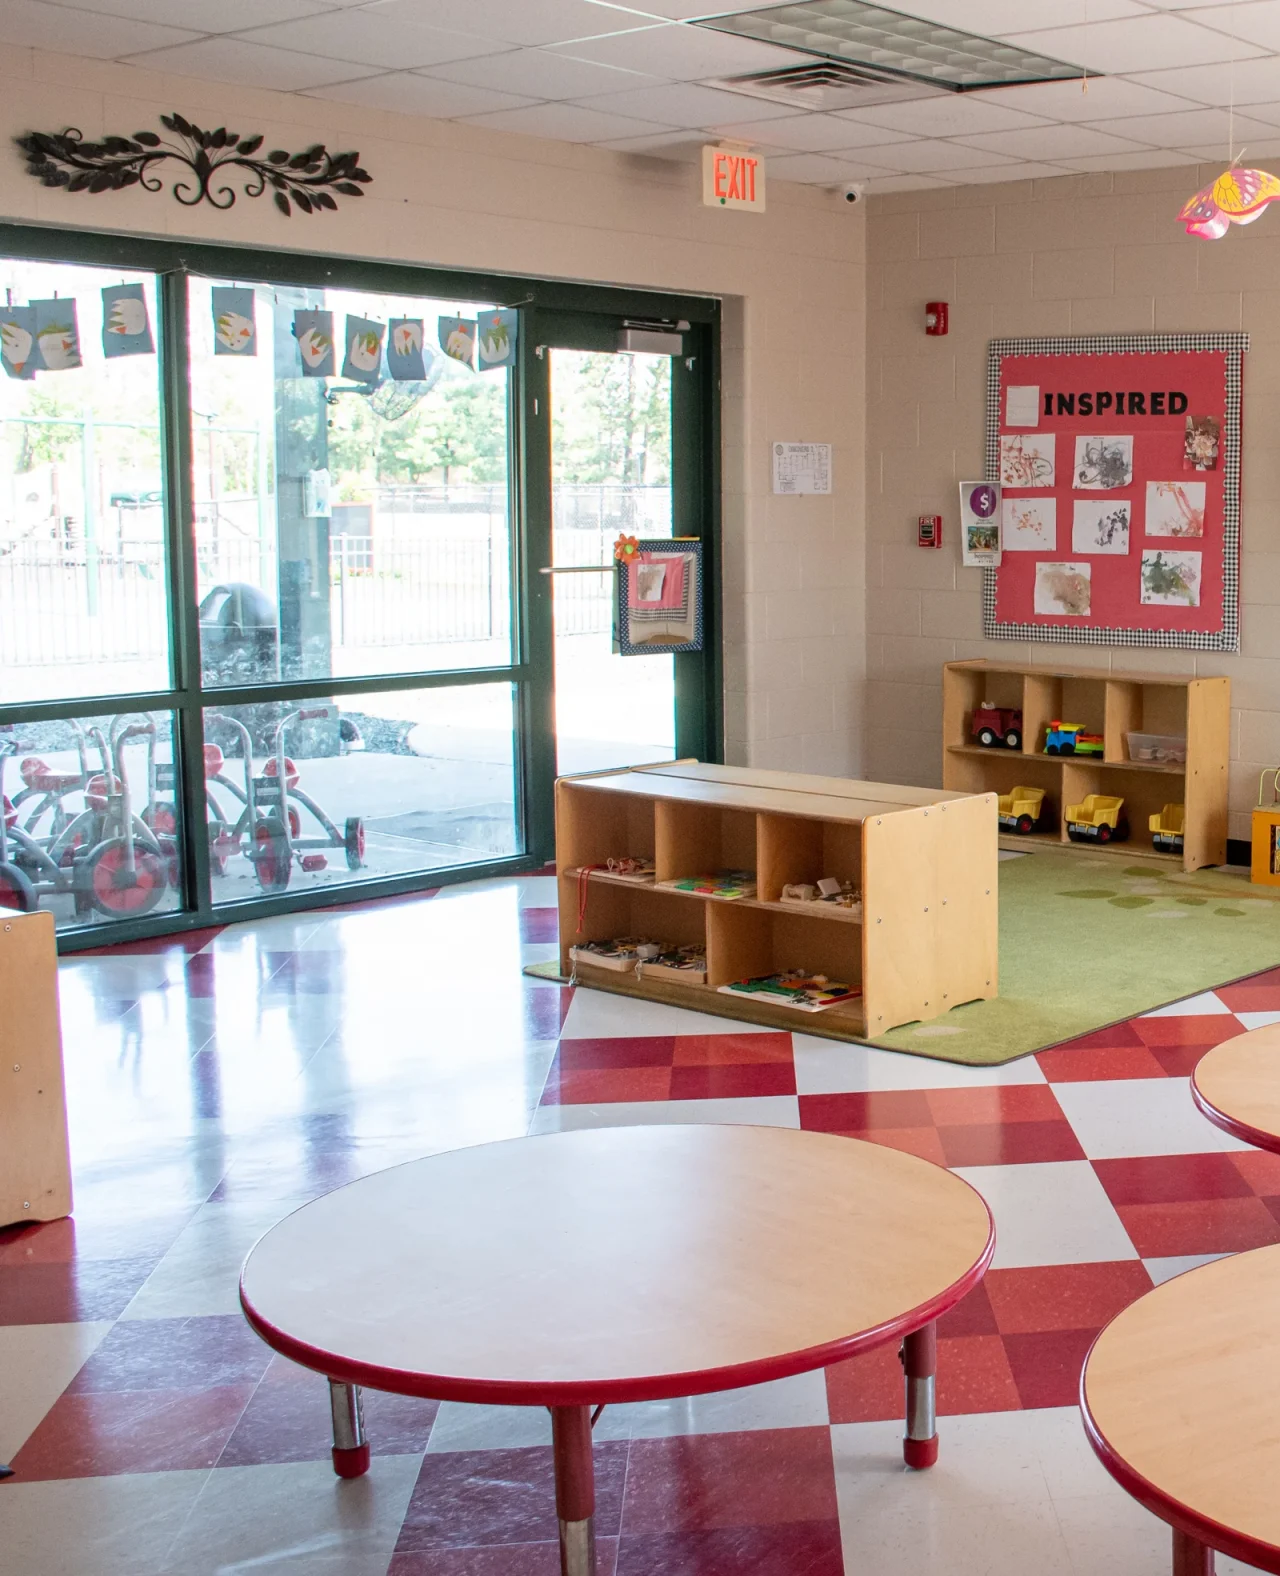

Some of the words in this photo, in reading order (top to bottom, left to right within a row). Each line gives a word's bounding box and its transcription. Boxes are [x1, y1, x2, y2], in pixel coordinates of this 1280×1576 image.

[713, 153, 757, 201] EXIT
[1044, 391, 1188, 416] INSPIRED
[920, 517, 935, 525] FIRE
